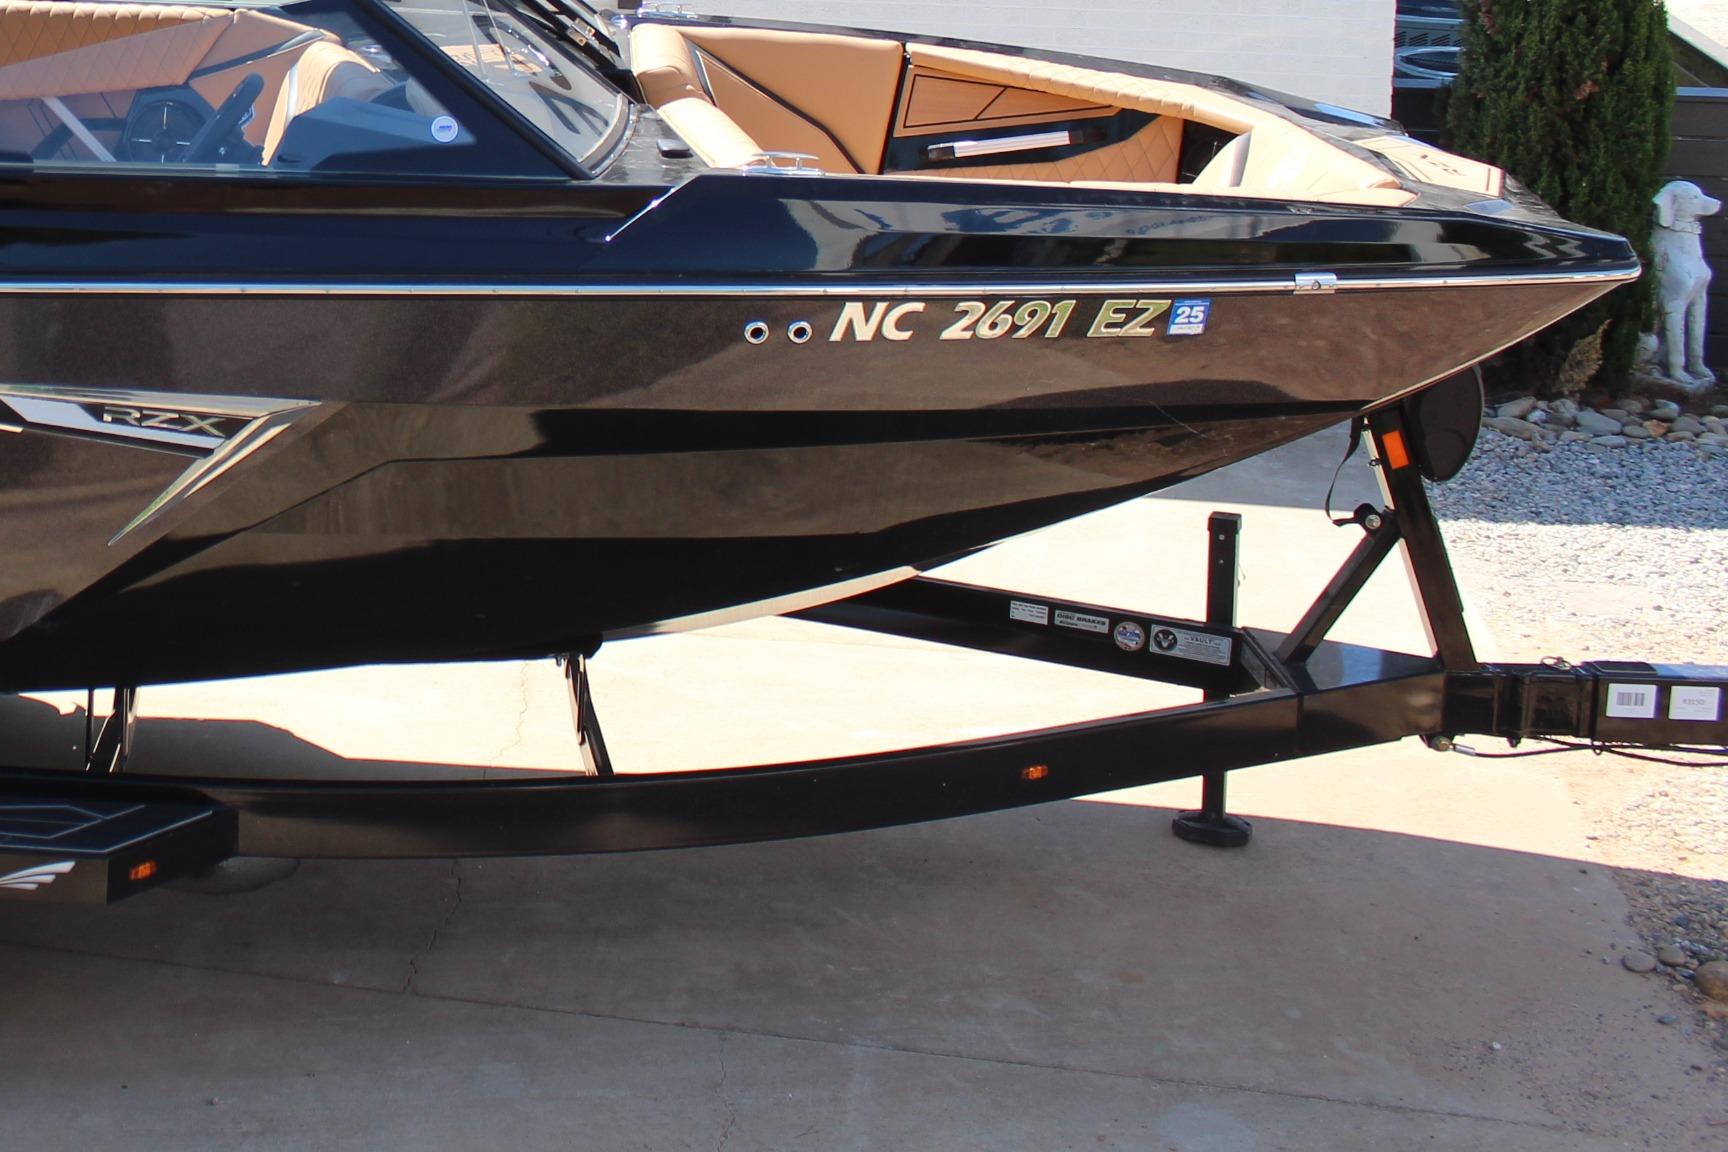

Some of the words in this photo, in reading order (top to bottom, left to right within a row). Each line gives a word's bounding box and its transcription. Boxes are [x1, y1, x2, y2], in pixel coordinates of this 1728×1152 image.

[828, 301, 926, 342] NC
[939, 299, 1077, 340] 2691
[1087, 299, 1172, 338] EZ
[1174, 305, 1205, 324] 25
[103, 406, 227, 439] RZX
